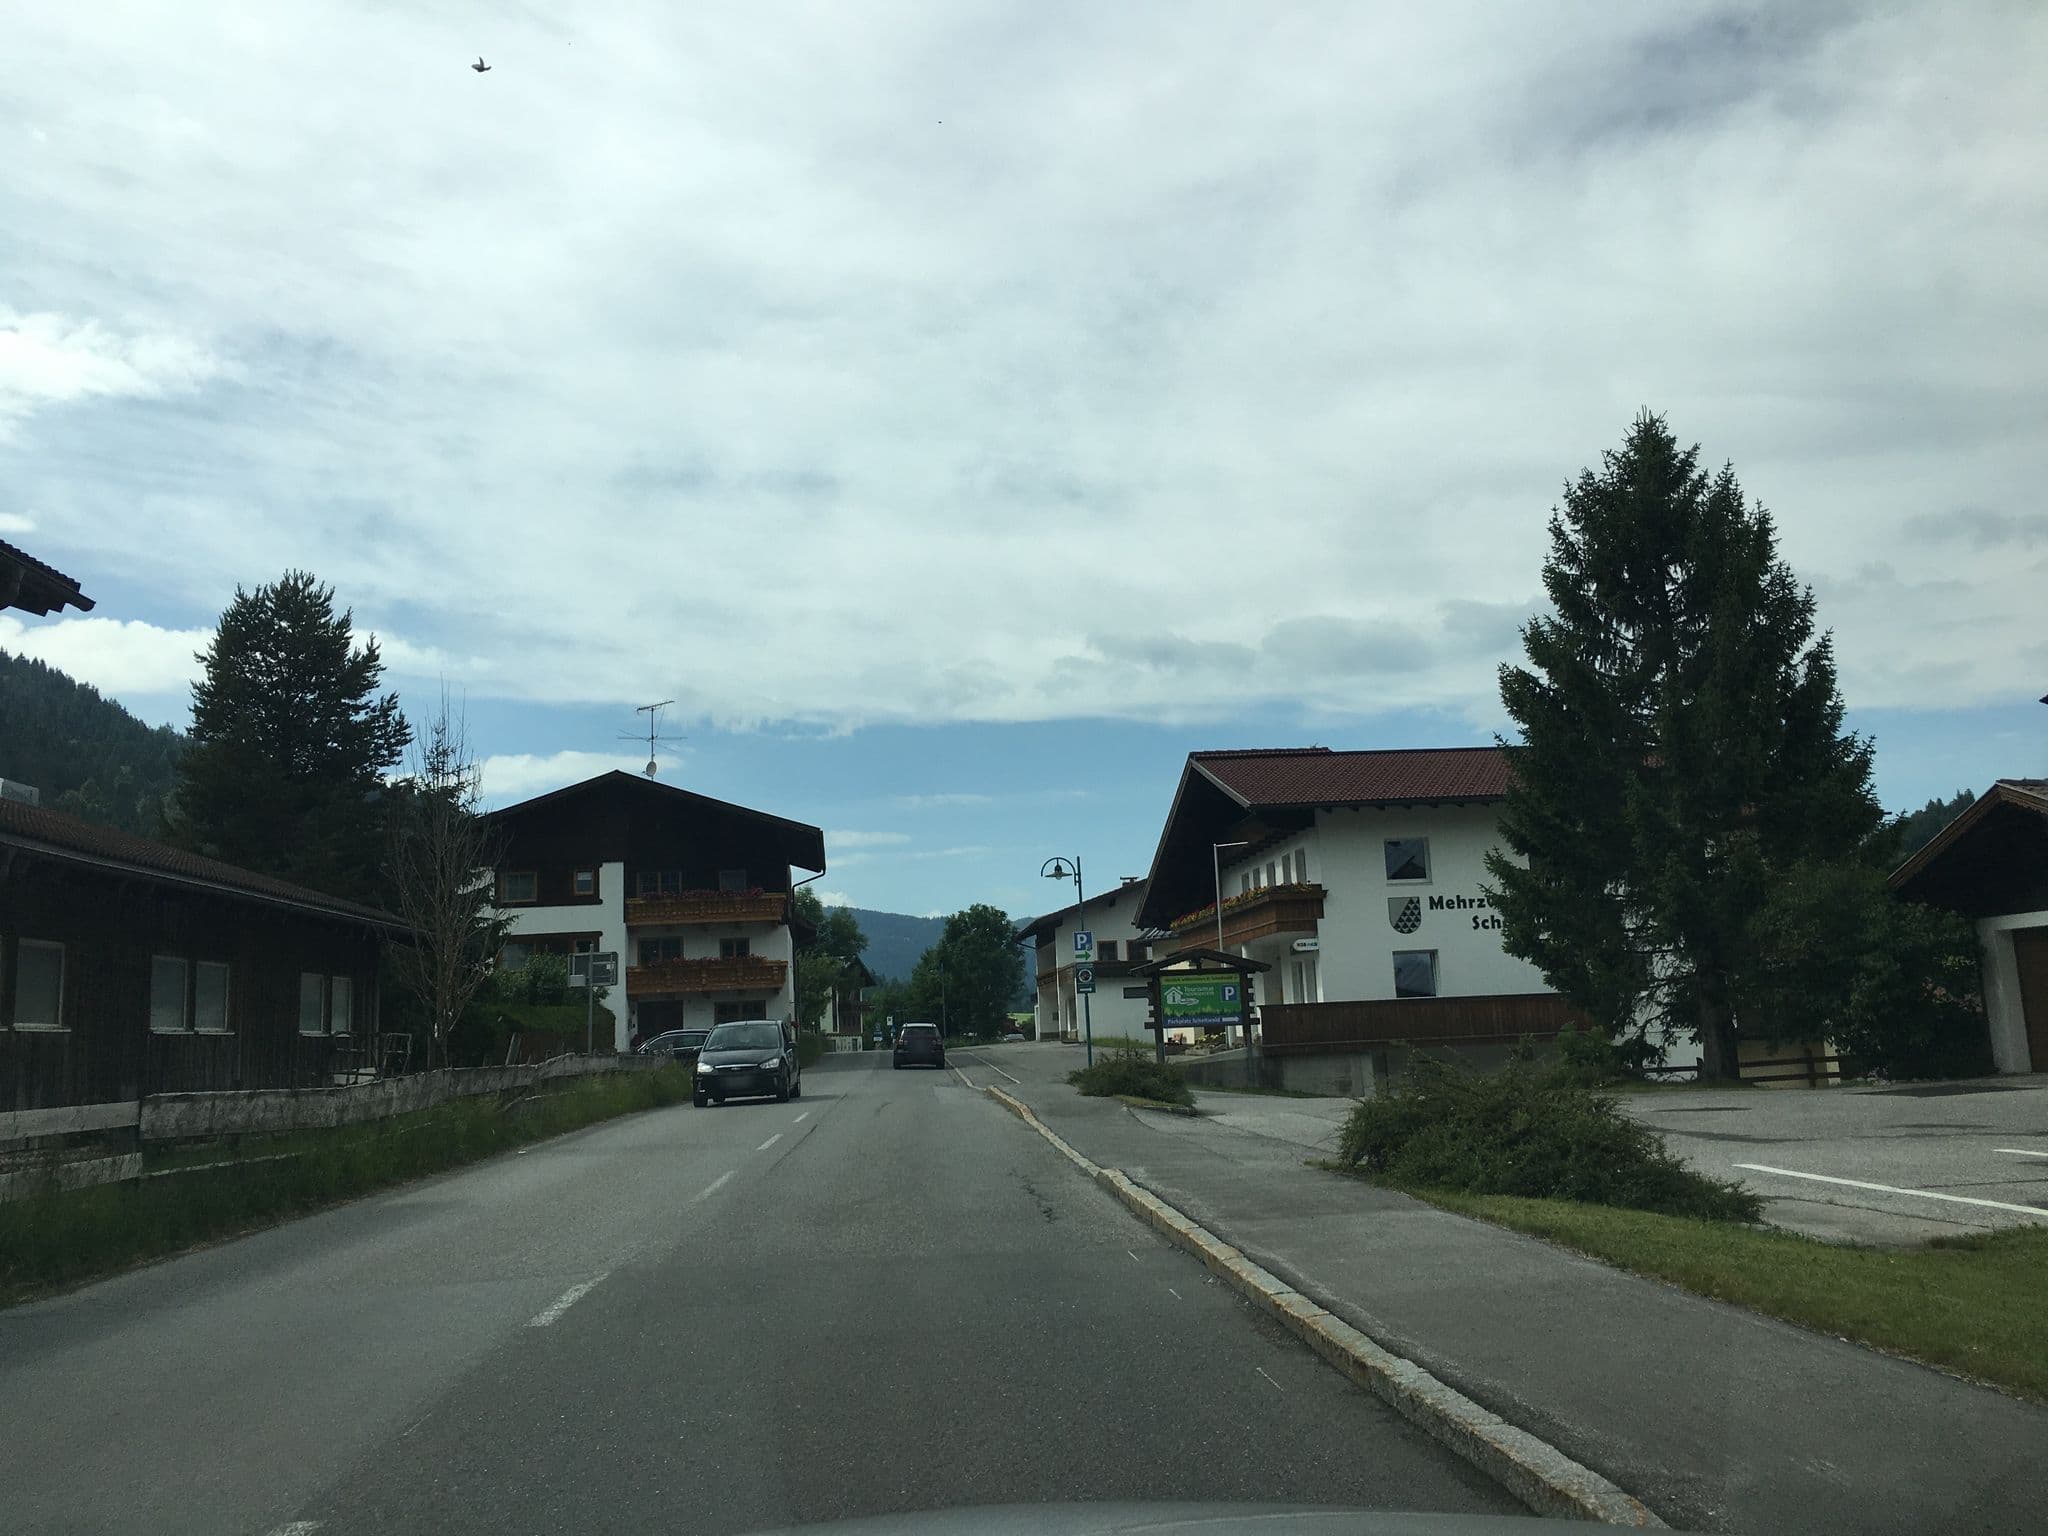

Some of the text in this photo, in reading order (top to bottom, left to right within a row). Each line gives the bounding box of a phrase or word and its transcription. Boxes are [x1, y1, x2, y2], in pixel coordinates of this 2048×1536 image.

[1471, 914, 1503, 931] Sch
[1076, 933, 1087, 949] P
[1224, 986, 1235, 1001] P
